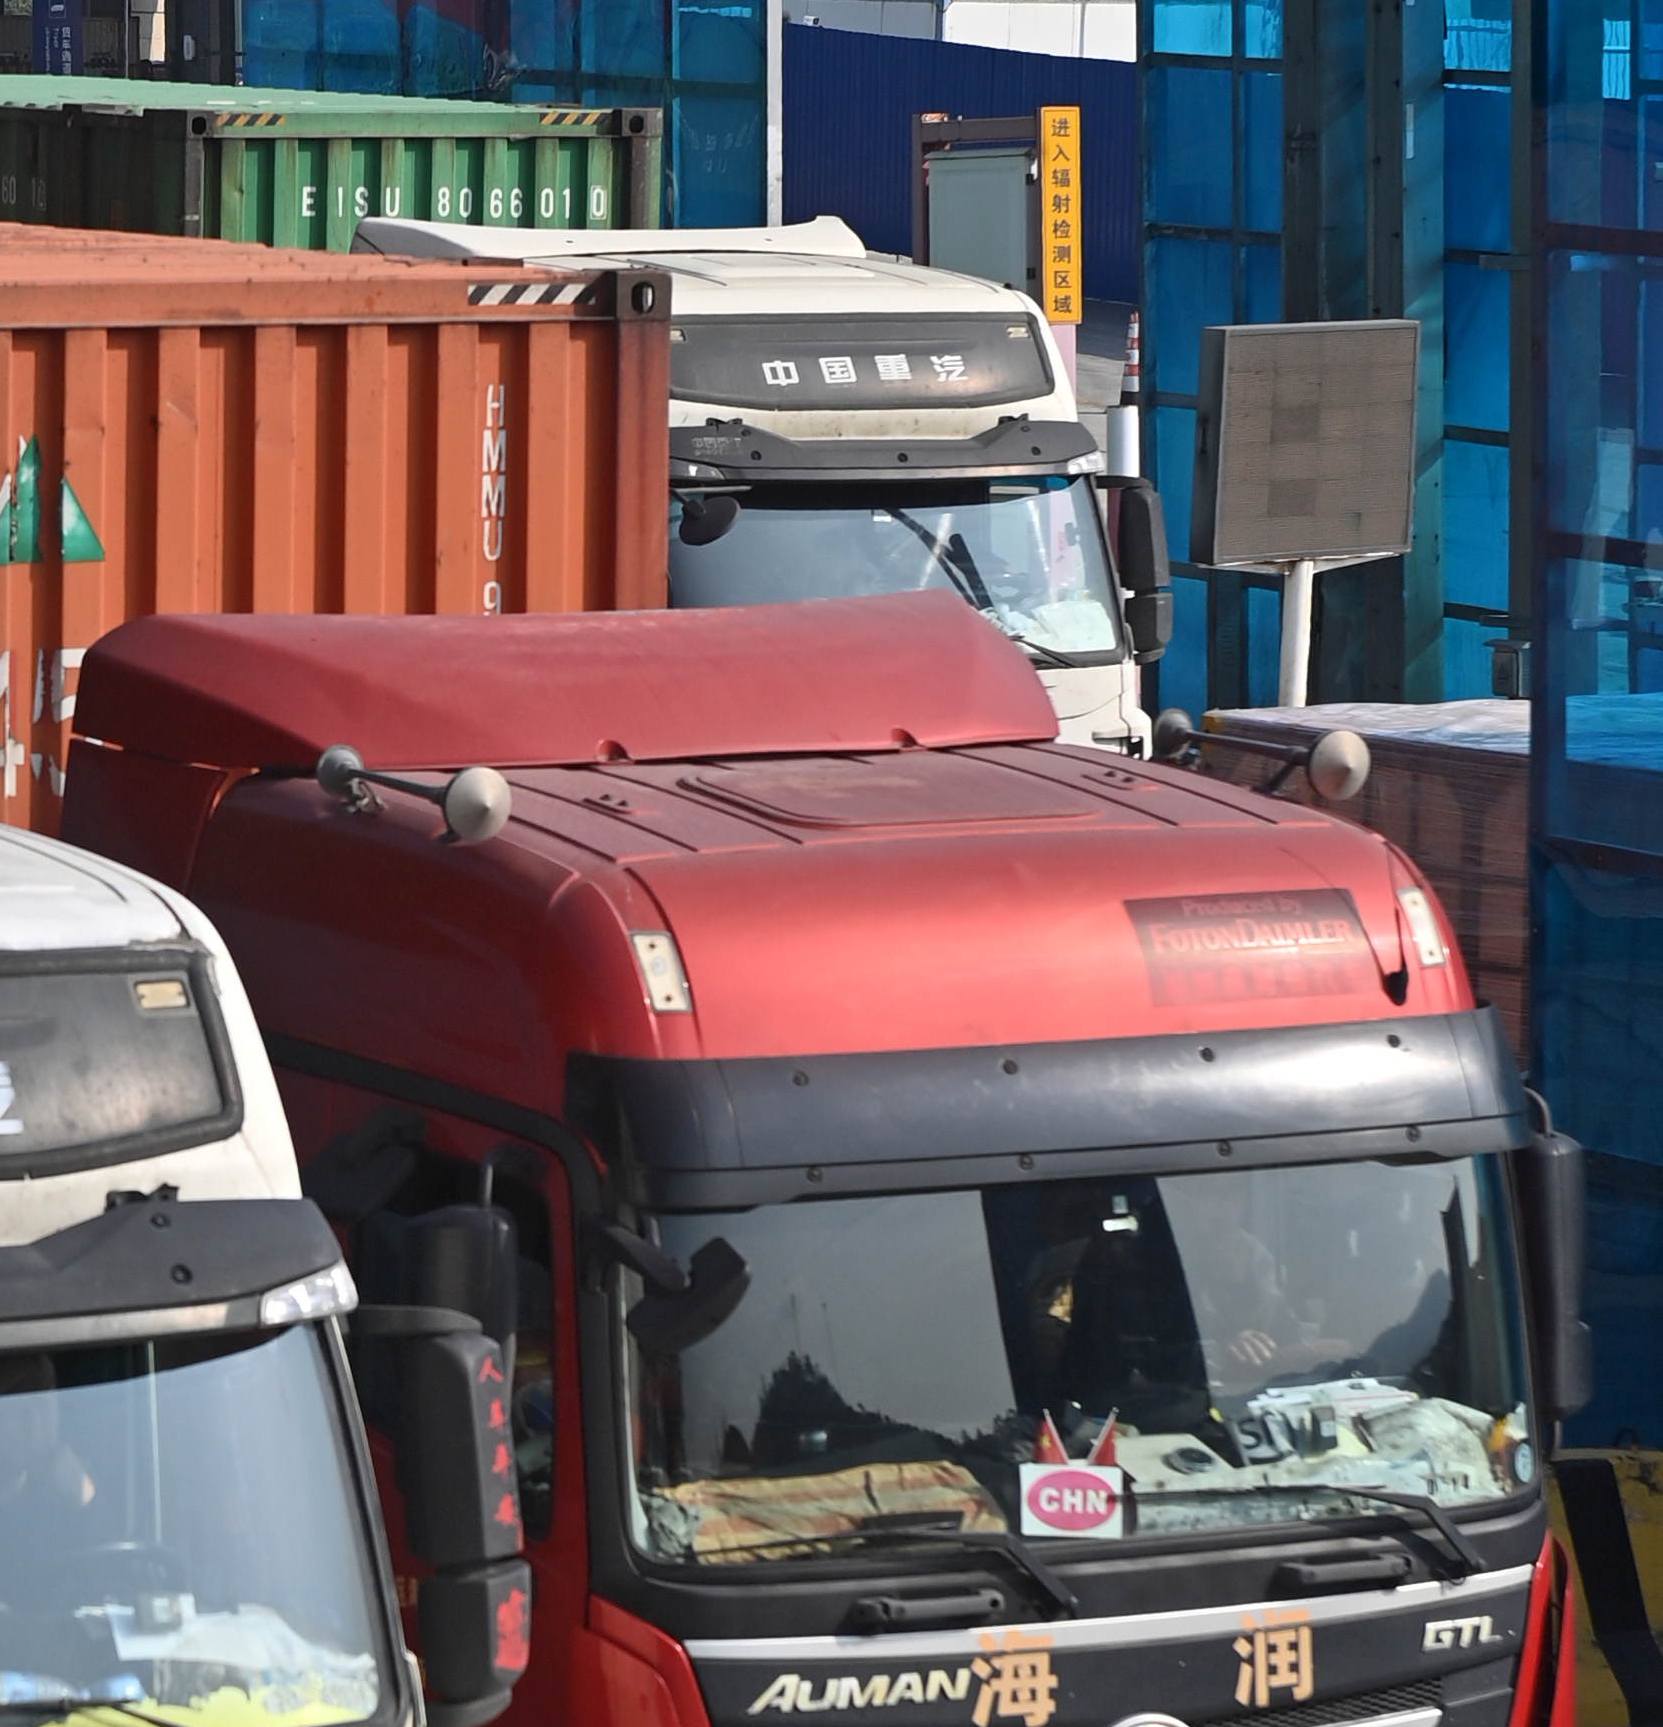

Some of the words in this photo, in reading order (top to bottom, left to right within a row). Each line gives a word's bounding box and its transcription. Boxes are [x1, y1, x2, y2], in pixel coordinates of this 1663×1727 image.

[301, 186, 401, 218] EISU
[1050, 117, 1074, 315] 进入辐射检测区域
[762, 354, 968, 386] 中国重汽
[480, 383, 506, 562] HMMU
[1038, 1484, 1109, 1516] CHN
[1421, 1615, 1504, 1653] GTL
[1232, 1608, 1315, 1709] 润
